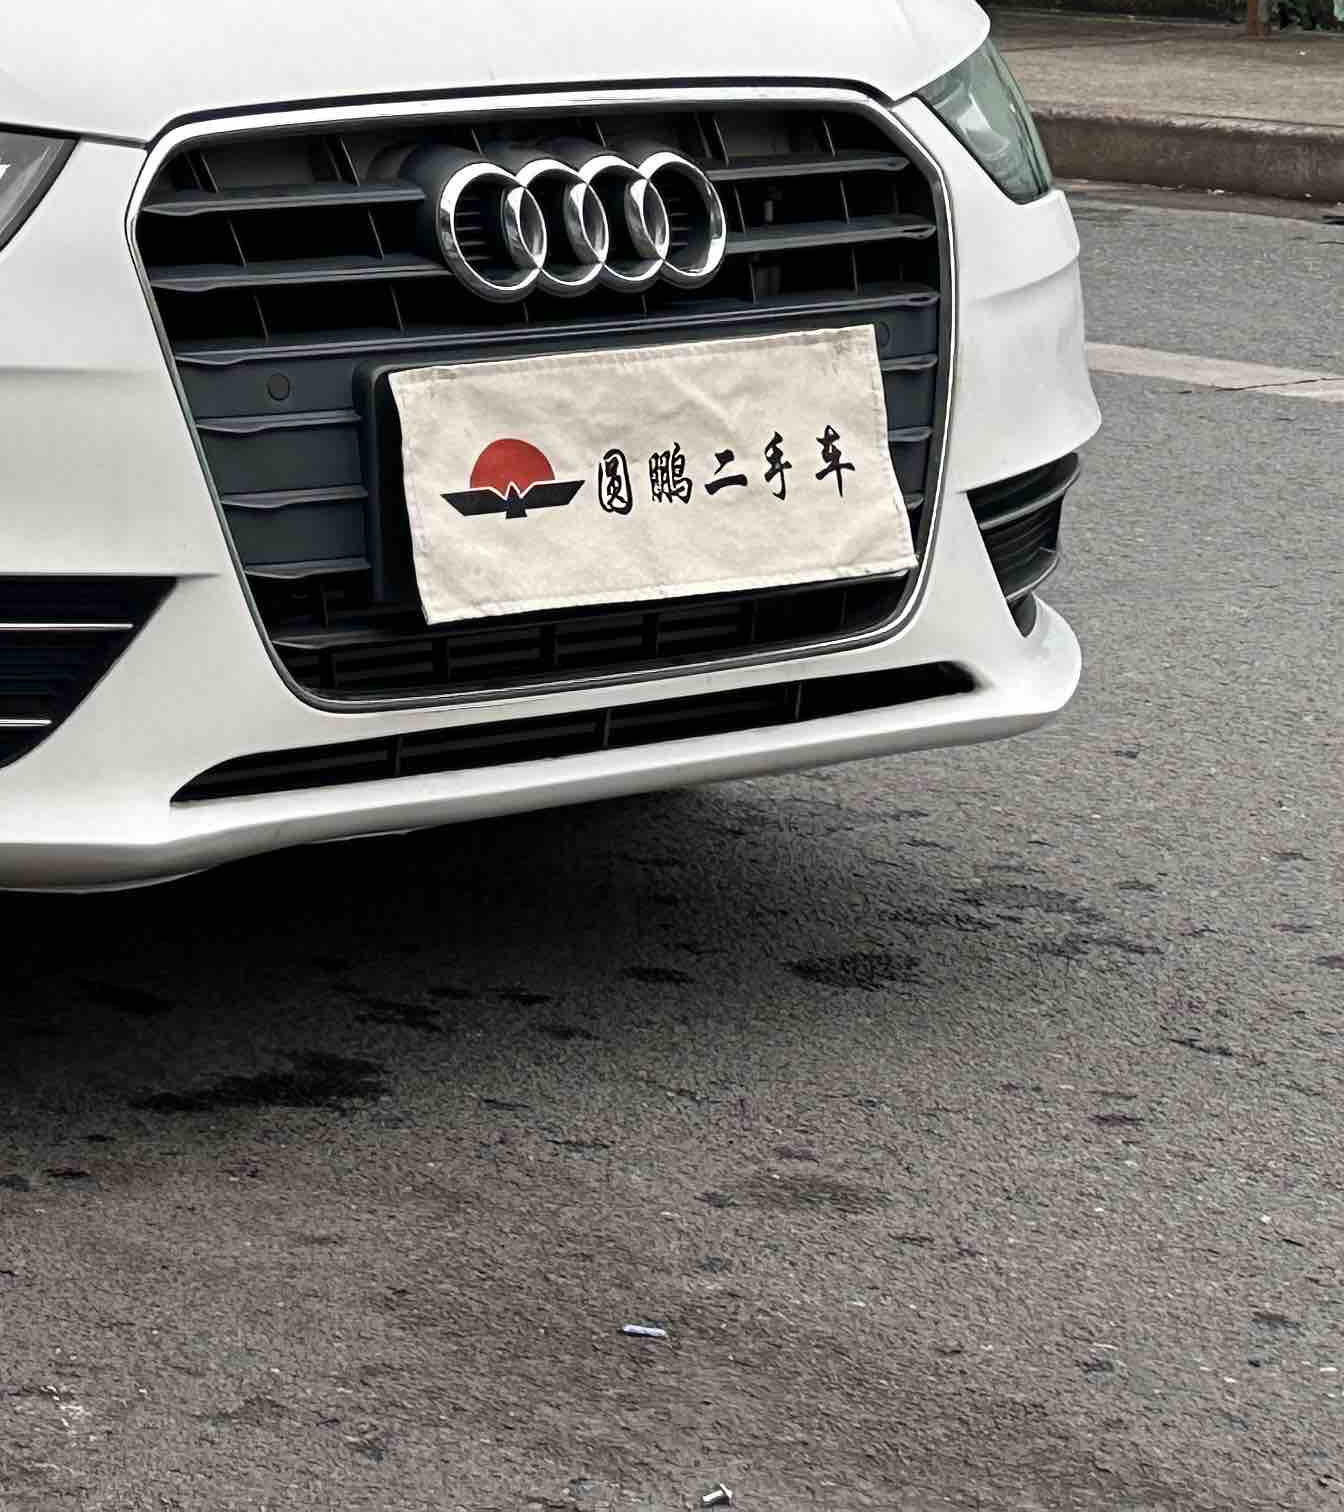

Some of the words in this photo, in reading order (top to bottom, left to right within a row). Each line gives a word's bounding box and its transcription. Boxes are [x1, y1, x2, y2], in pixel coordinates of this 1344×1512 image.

[597, 424, 856, 517] 圆鹏二手车
